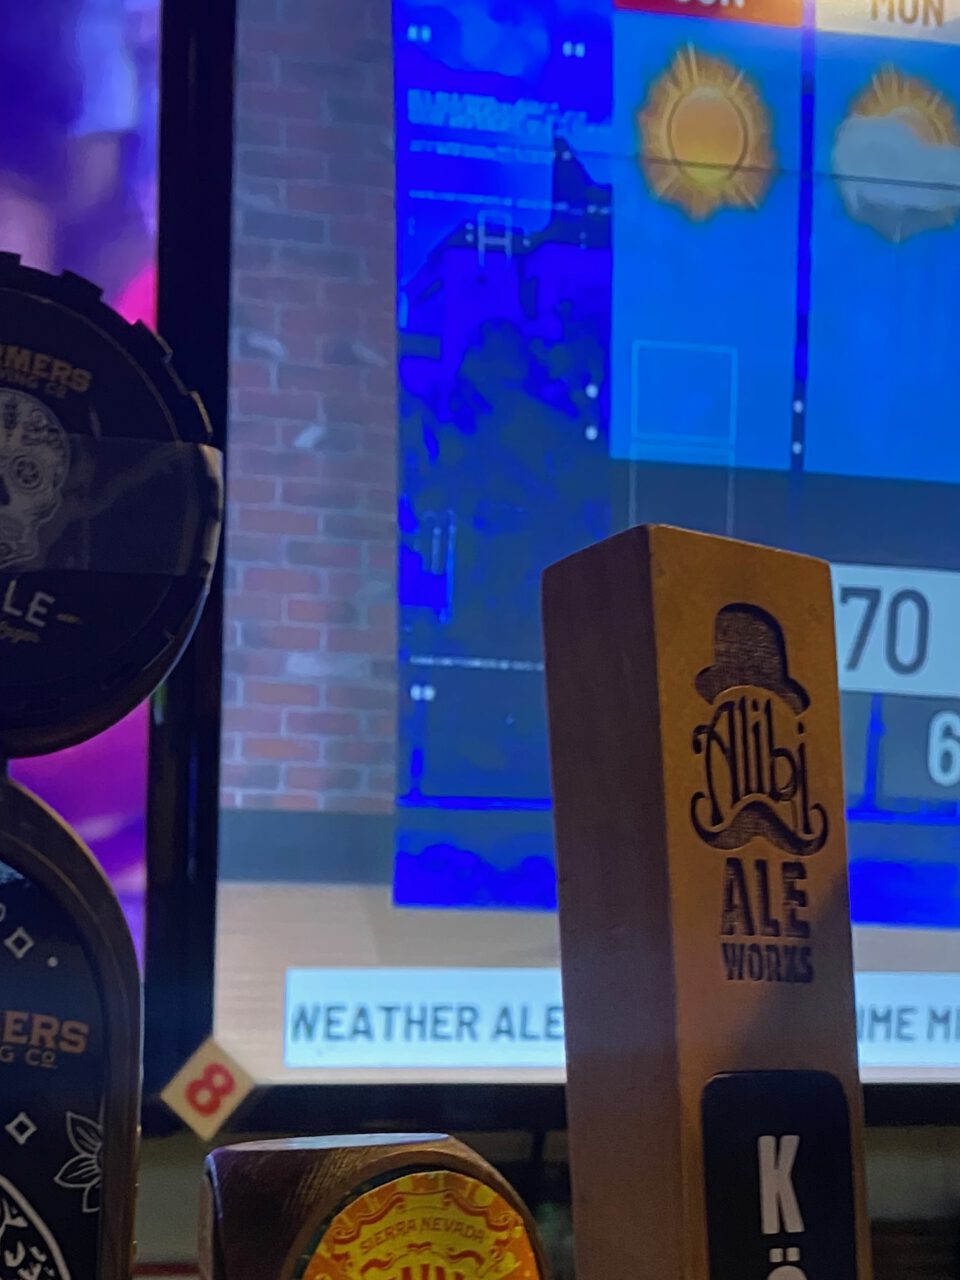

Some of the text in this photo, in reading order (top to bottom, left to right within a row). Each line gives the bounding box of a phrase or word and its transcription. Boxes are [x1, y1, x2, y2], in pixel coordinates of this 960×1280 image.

[839, 586, 930, 676] 70
[692, 696, 808, 836] Alibi
[720, 856, 813, 940] ALE
[721, 942, 816, 985] WORKS
[291, 1002, 480, 1042] WEATHER
[186, 1062, 238, 1119] 8
[359, 1215, 487, 1256] SIERRA NEVADA
